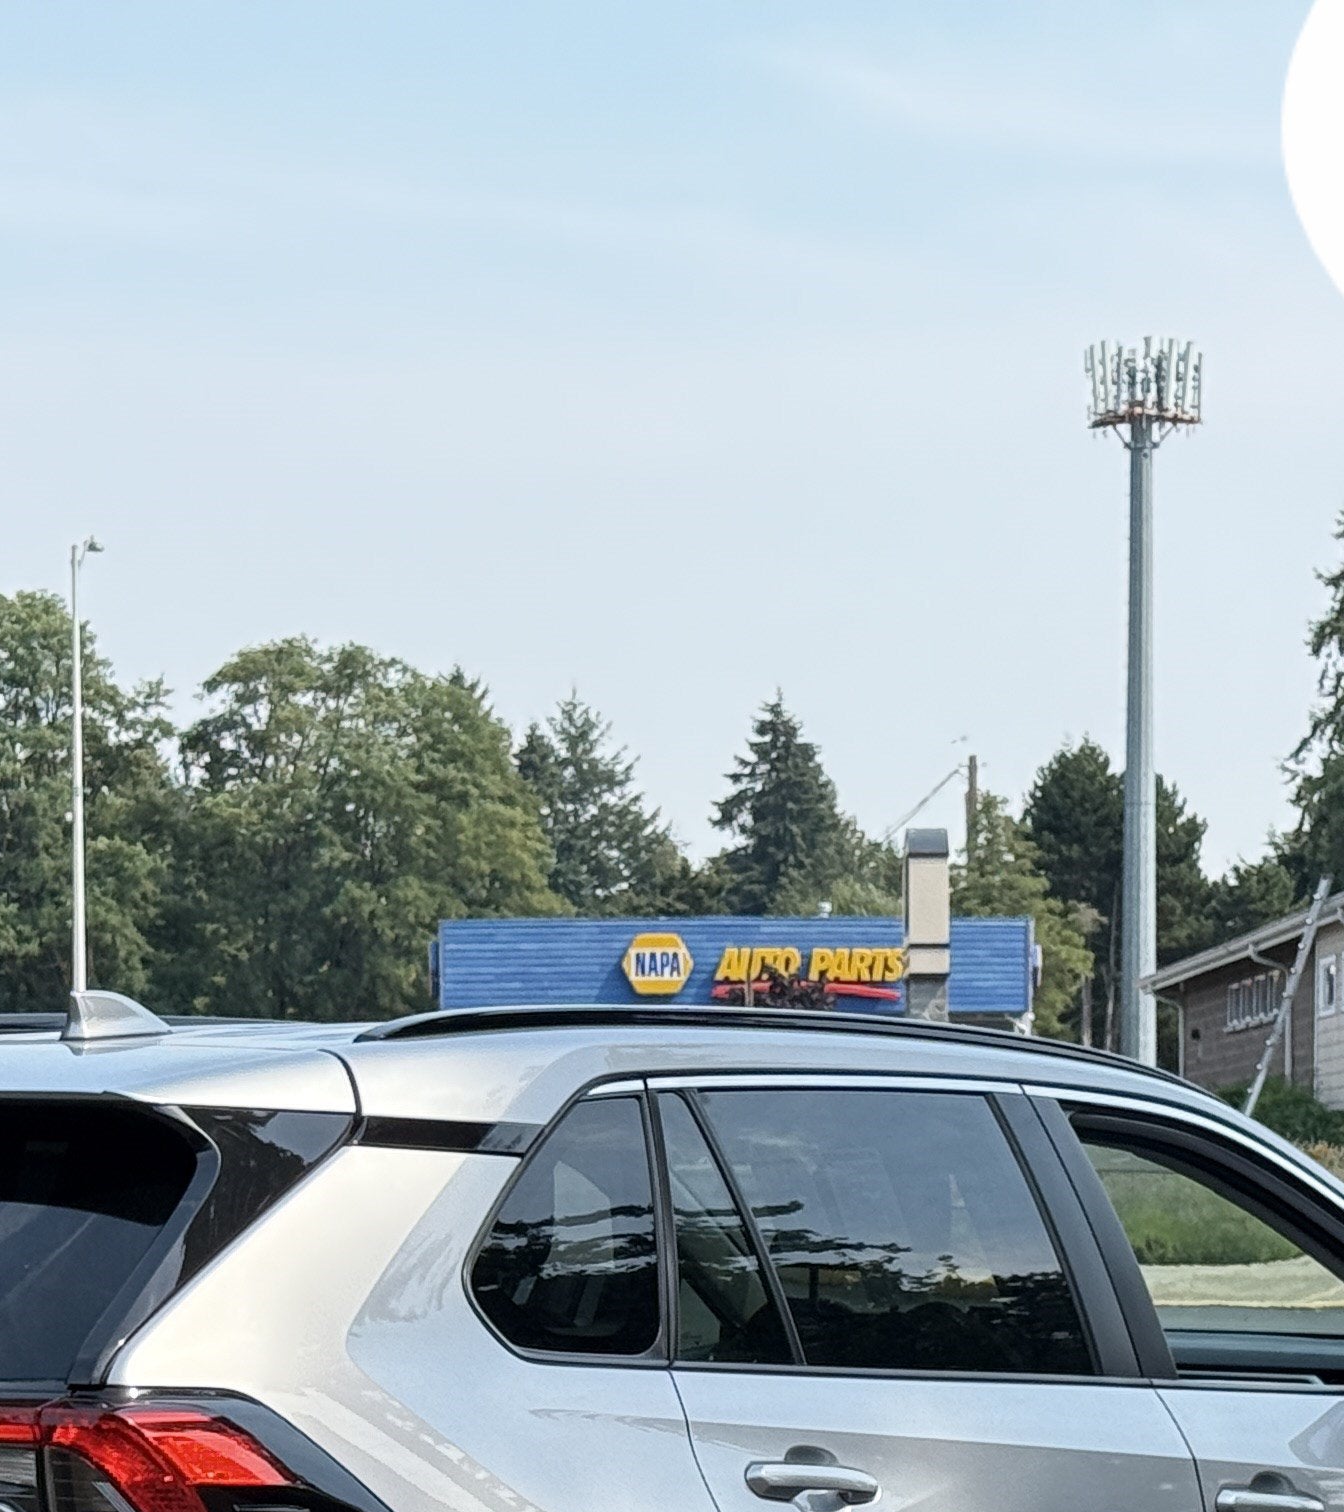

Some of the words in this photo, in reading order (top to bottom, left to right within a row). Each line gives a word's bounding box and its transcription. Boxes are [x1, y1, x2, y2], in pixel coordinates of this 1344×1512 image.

[635, 951, 681, 977] NAPA
[713, 946, 802, 981] AUTO
[809, 946, 904, 982] PARTS
